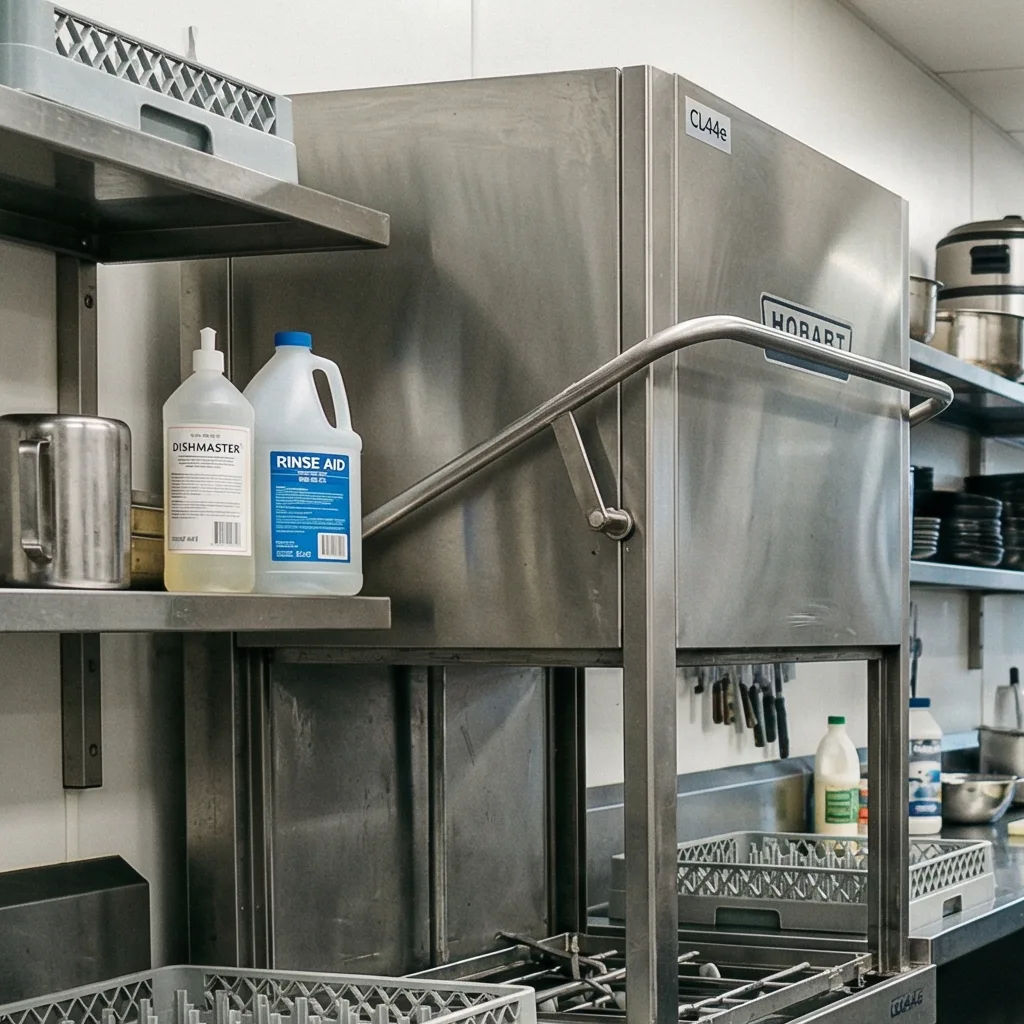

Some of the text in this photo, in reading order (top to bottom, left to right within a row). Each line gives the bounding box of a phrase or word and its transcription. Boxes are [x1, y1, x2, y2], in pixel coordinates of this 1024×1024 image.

[690, 108, 728, 142] CL44e
[772, 310, 845, 350] HOBART
[172, 442, 240, 454] DISHMASTER
[276, 455, 346, 471] RINSE AID
